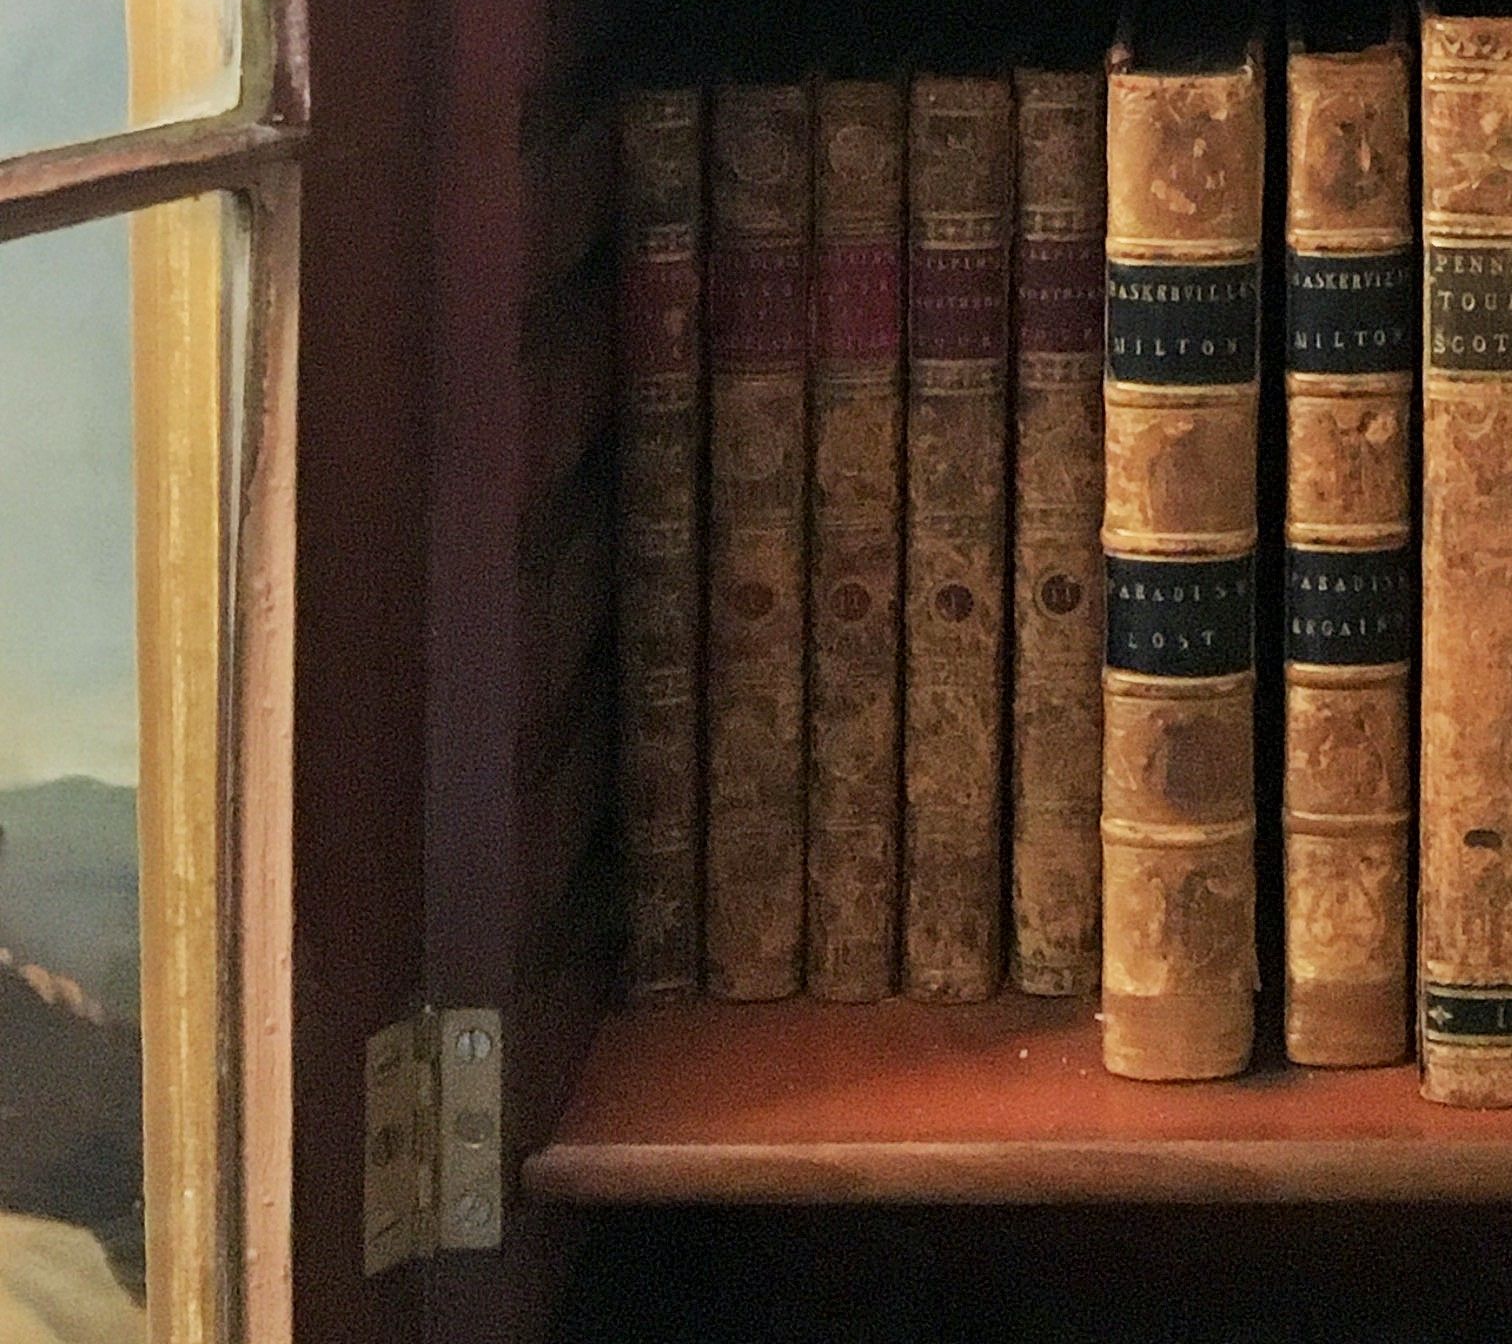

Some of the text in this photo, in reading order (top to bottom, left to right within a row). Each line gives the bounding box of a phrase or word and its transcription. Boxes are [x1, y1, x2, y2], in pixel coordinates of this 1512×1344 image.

[1113, 337, 1237, 356] MILTON
[1294, 329, 1401, 349] MILTO
[1128, 630, 1214, 649] LOST
